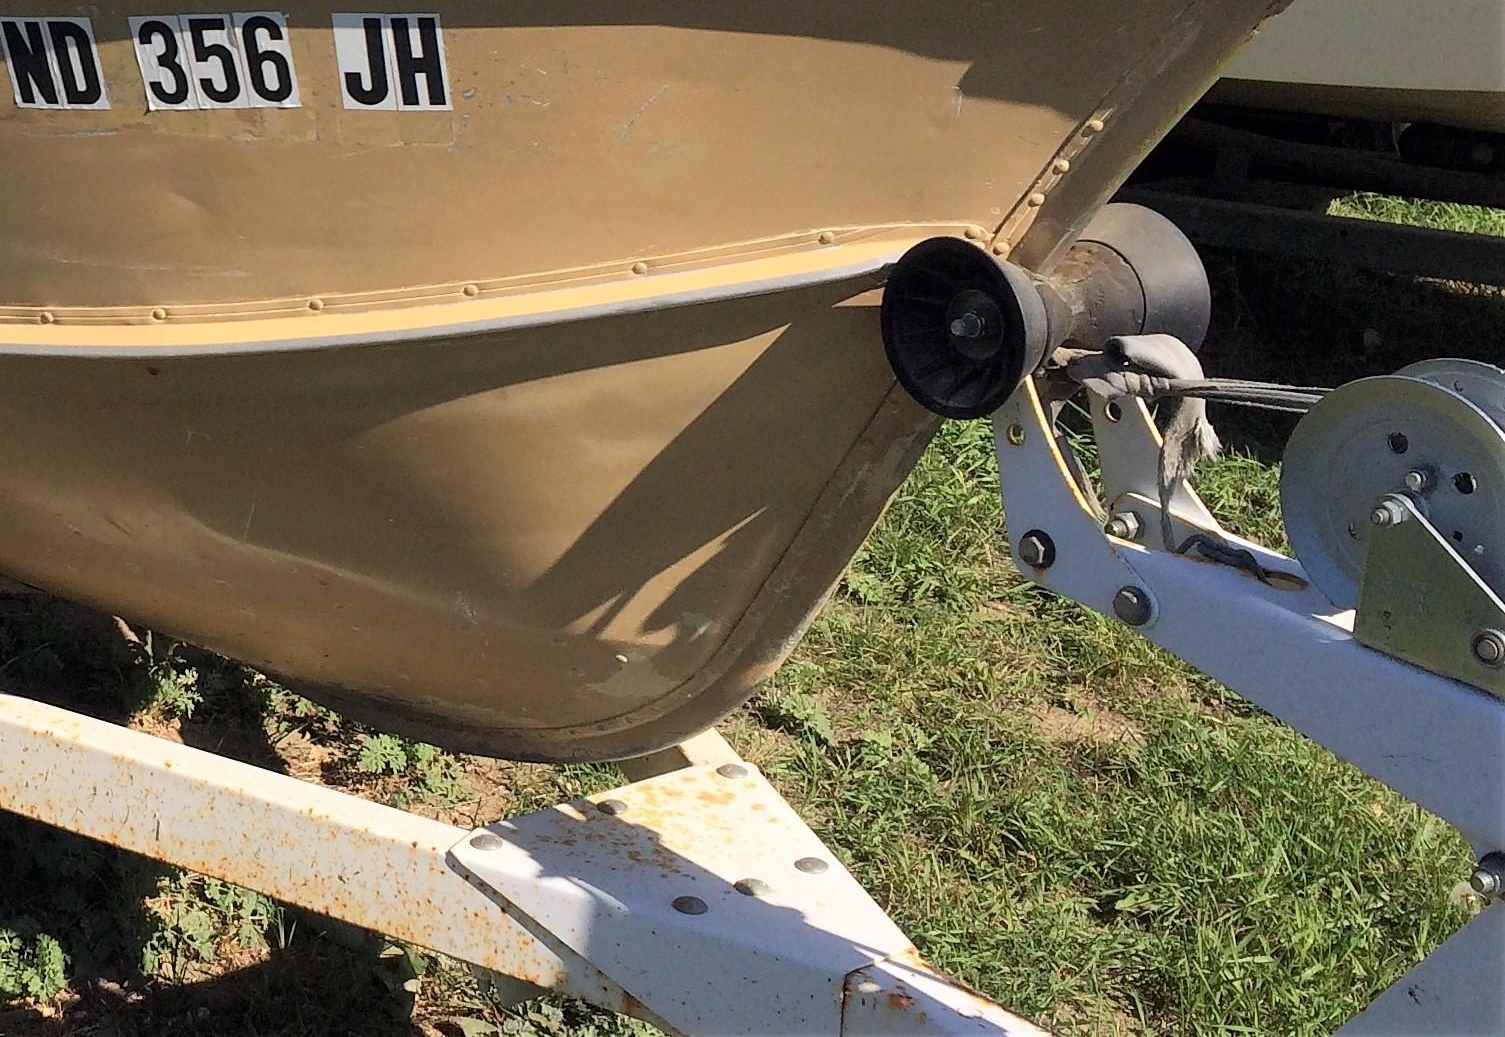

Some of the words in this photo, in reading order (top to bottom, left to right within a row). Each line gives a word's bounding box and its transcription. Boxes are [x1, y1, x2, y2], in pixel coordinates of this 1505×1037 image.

[1, 21, 101, 104] ND
[138, 15, 293, 104] 356
[345, 17, 447, 105] JH
